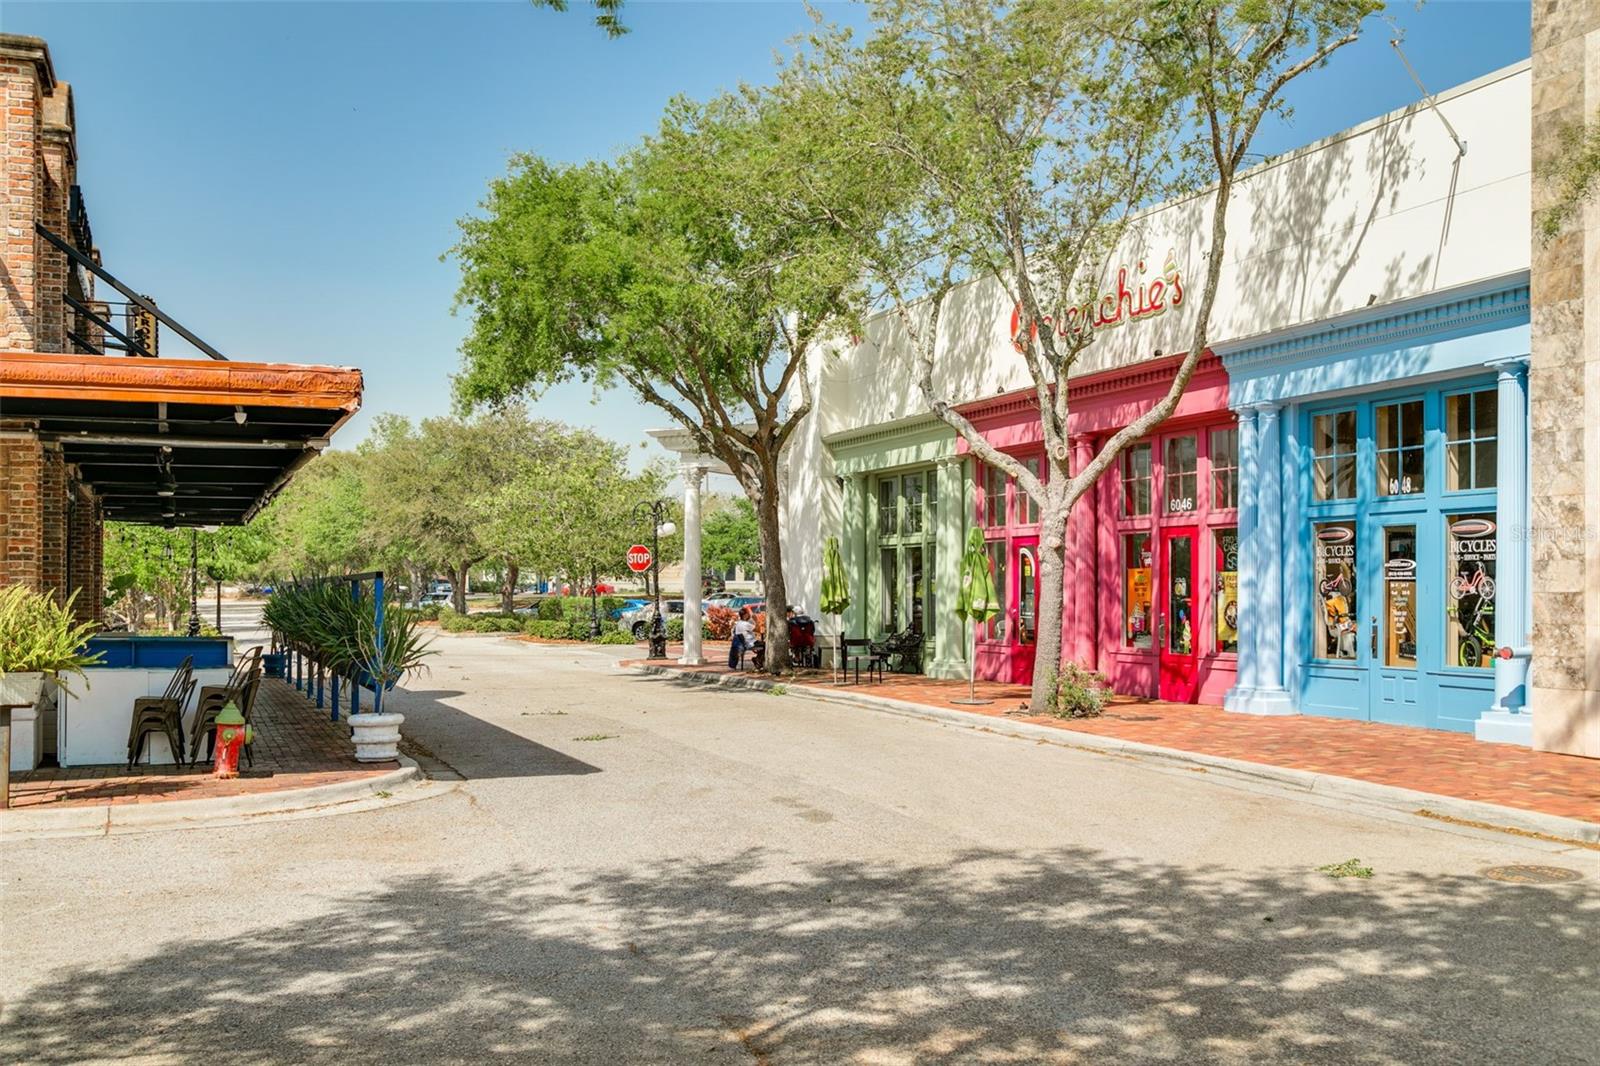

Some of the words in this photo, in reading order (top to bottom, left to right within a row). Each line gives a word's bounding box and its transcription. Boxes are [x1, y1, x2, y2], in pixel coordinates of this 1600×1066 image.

[1390, 475, 1411, 494] 6048
[1170, 498, 1192, 511] 6046
[628, 553, 650, 564] STOP
